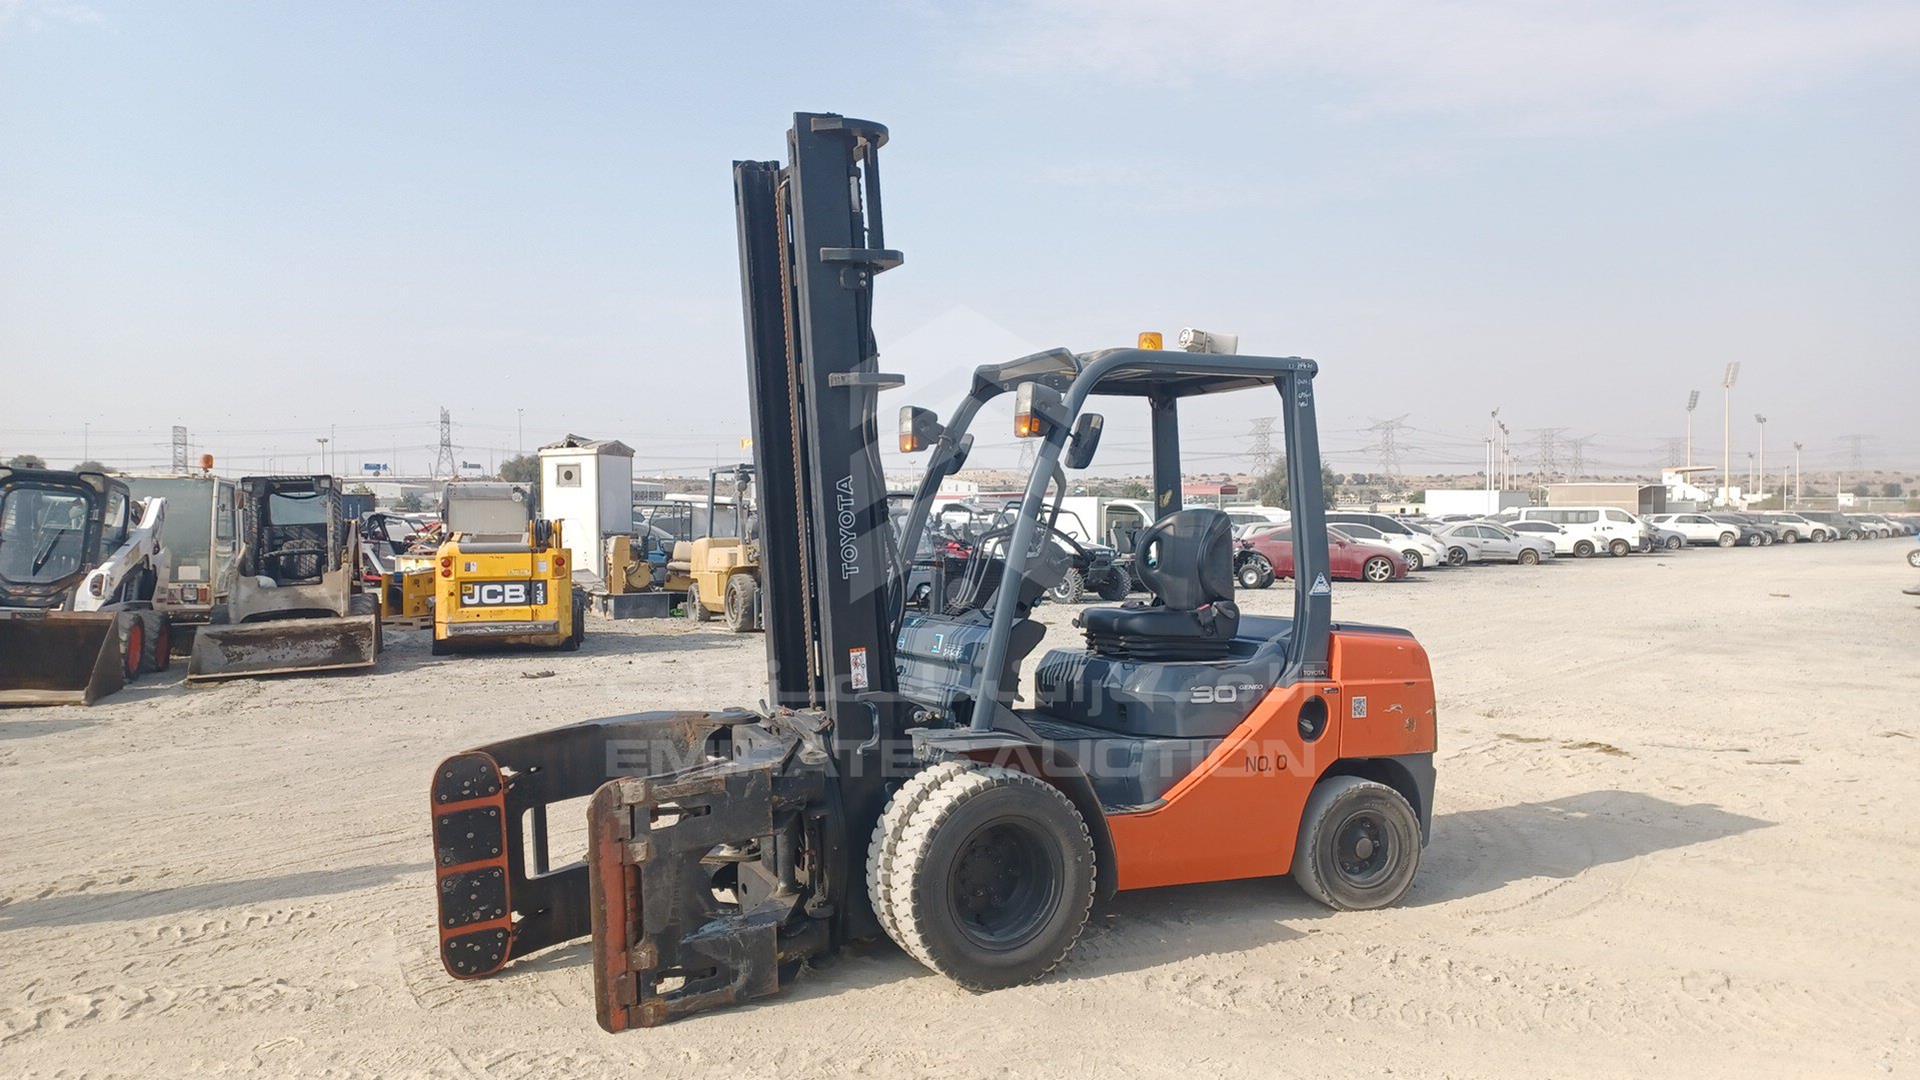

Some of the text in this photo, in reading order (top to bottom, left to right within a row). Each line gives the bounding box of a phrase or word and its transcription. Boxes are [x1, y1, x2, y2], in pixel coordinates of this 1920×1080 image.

[836, 475, 860, 580] TOYOTA
[462, 584, 526, 604] JCB
[1303, 669, 1325, 677] TOYOTA
[1190, 685, 1237, 704] 30
